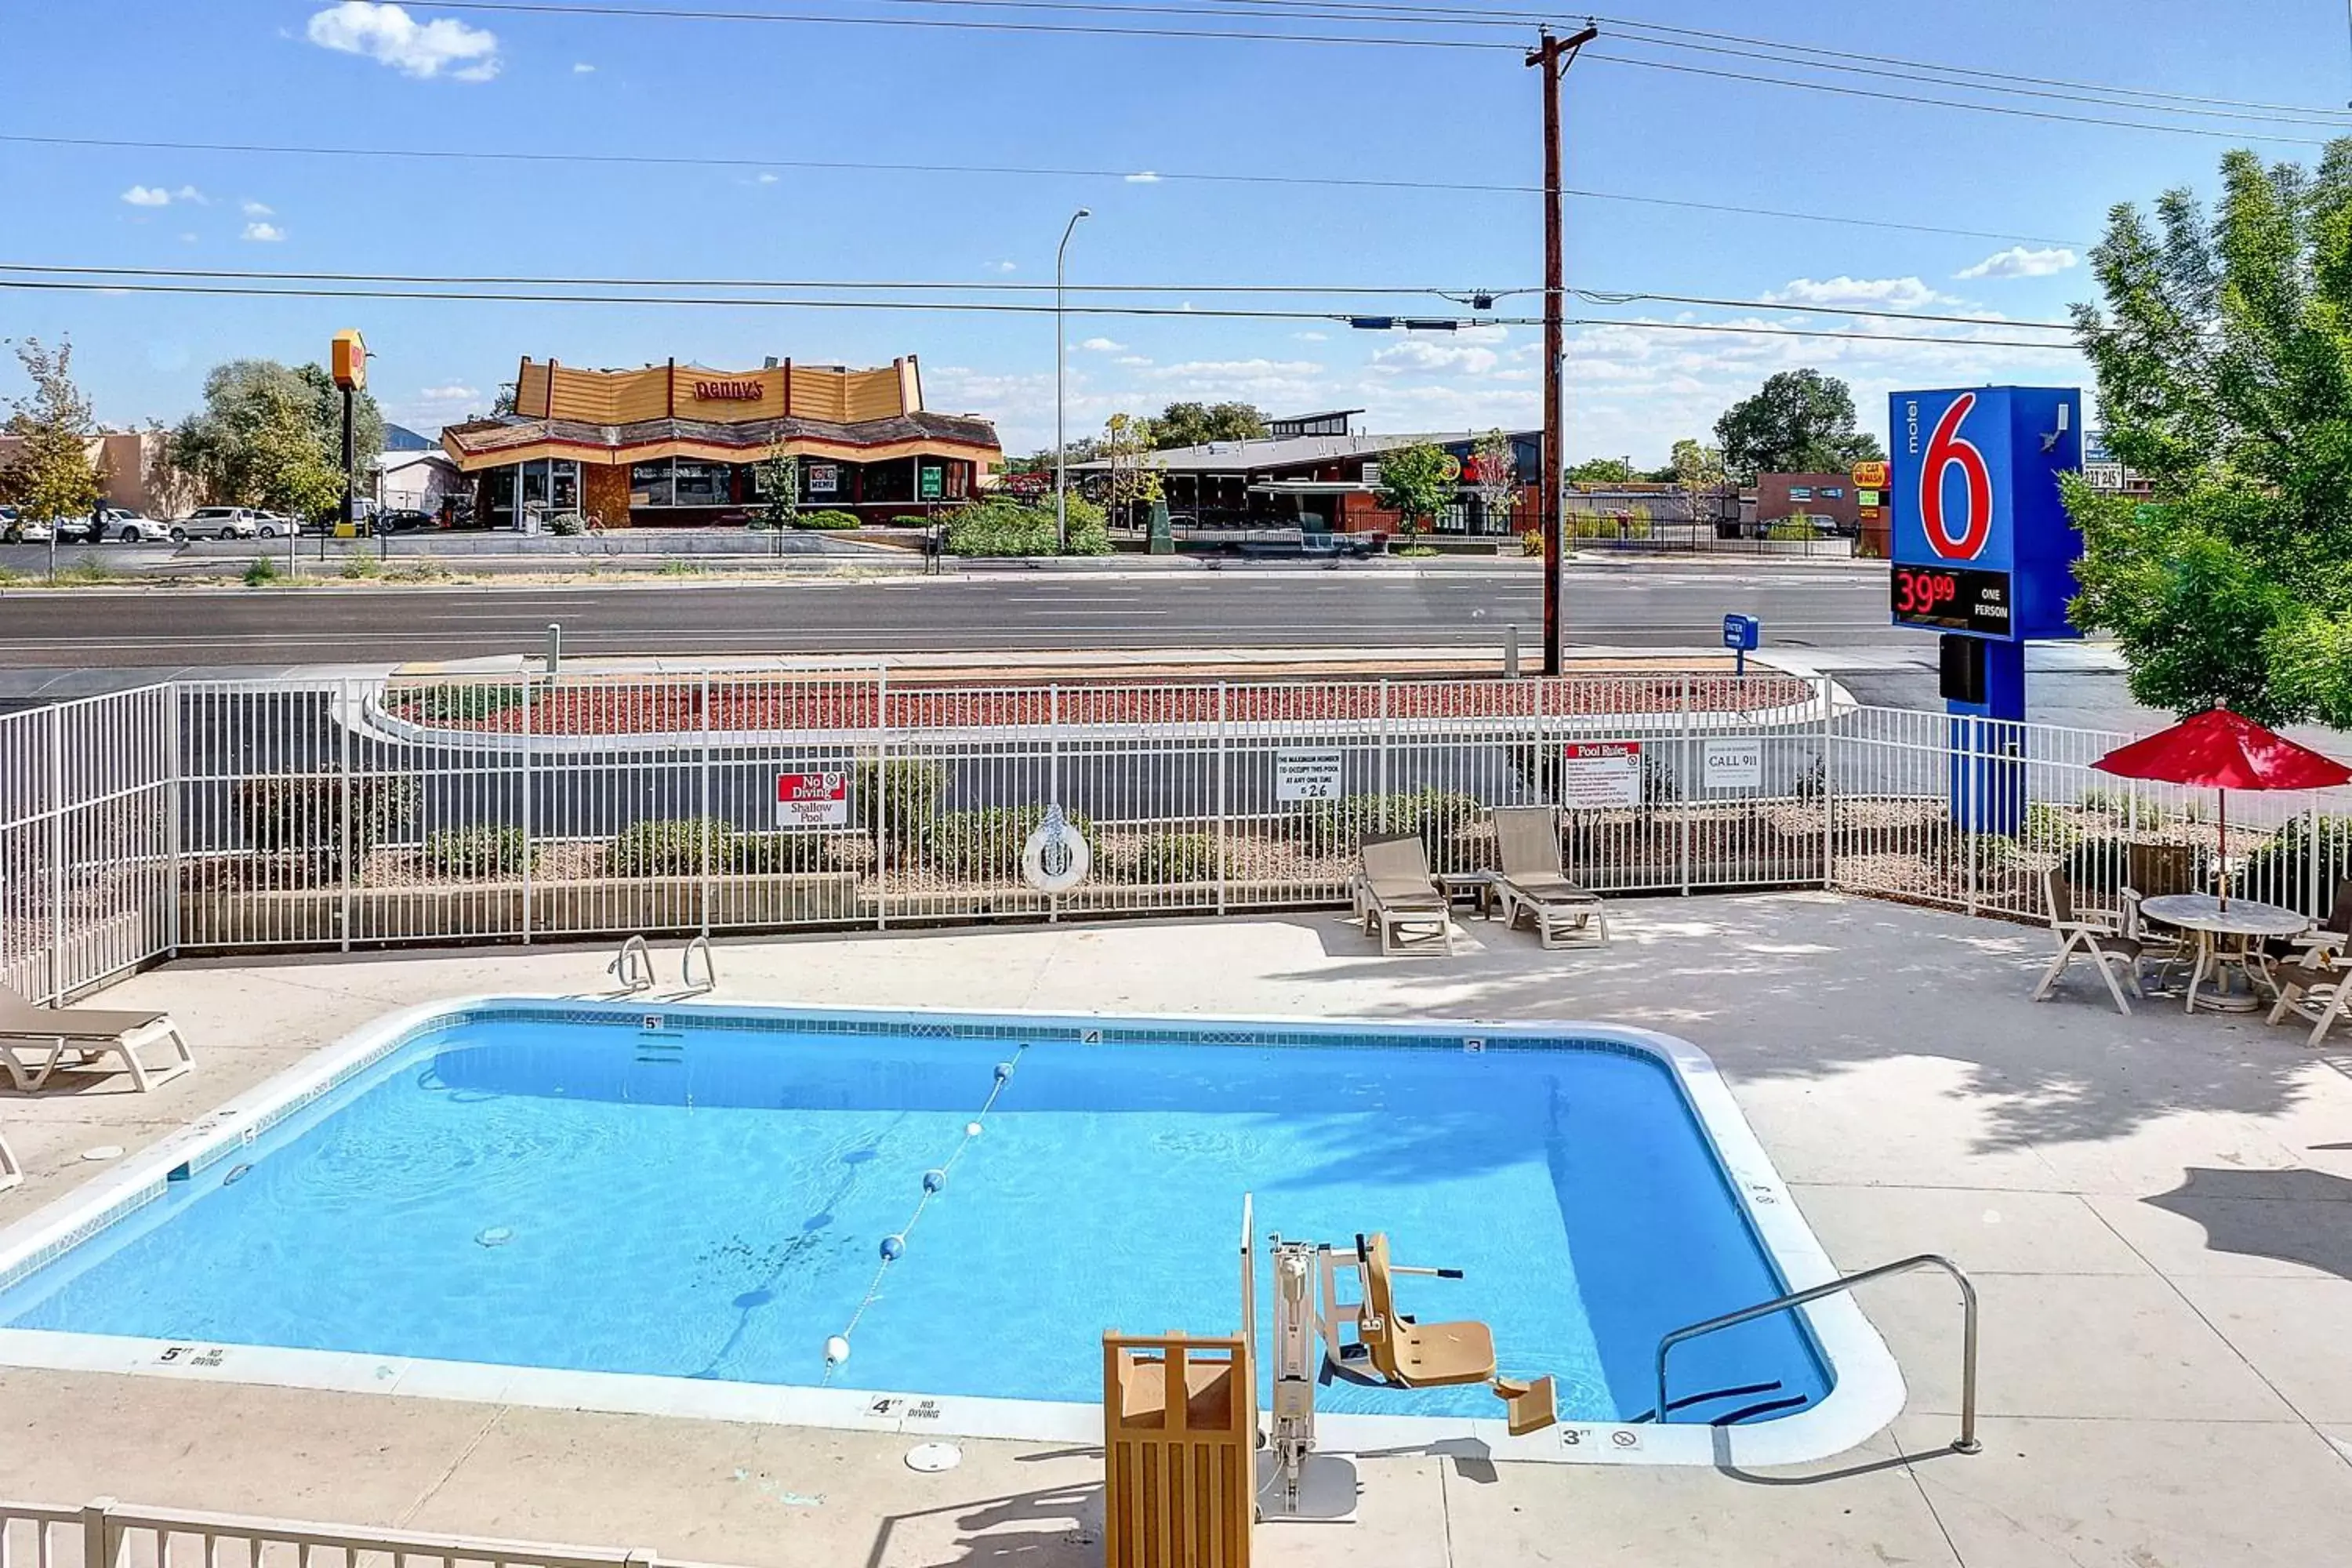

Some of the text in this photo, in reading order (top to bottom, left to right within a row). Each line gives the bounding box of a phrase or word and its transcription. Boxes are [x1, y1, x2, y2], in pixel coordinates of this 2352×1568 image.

[693, 380, 765, 401] Denny's
[1906, 392, 1992, 560] motel 6
[1981, 588, 2001, 600] ONE
[1975, 604, 2008, 618] PERSON
[1578, 746, 1600, 757] Pool
[1709, 755, 1757, 767] CALL 911
[802, 775, 821, 787] No
[792, 786, 832, 800] Diving
[791, 802, 833, 813] Shallow
[800, 813, 823, 823] Pool
[920, 1400, 935, 1409] NO
[907, 1408, 940, 1418] DIVING
[1563, 1429, 1580, 1445] 3
